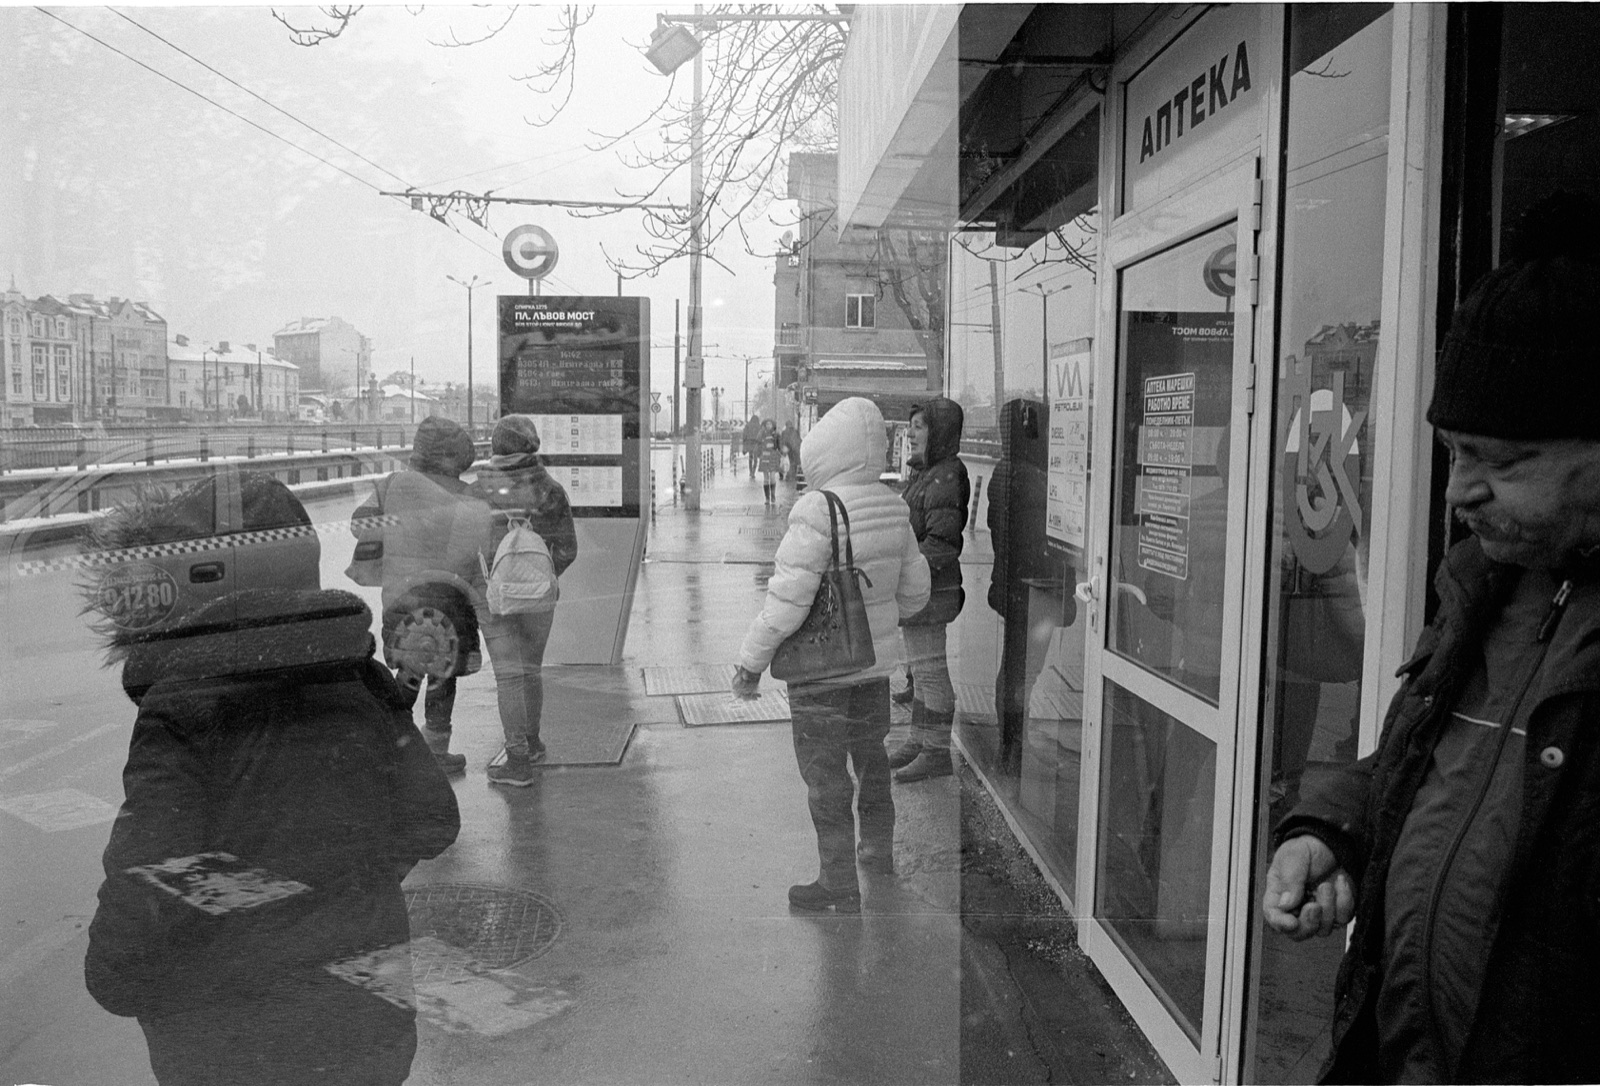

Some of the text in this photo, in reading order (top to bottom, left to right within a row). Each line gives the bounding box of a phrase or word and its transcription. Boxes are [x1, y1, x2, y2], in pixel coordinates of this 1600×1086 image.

[1140, 40, 1251, 164] АПТЕКА
[515, 311, 595, 321] ПЛ. ЛЪВОВ МОСТ
[1146, 376, 1194, 394] АПТЕКА МАРЕШКИ
[1147, 395, 1190, 412] РАБОТНО ВРЕМЕ
